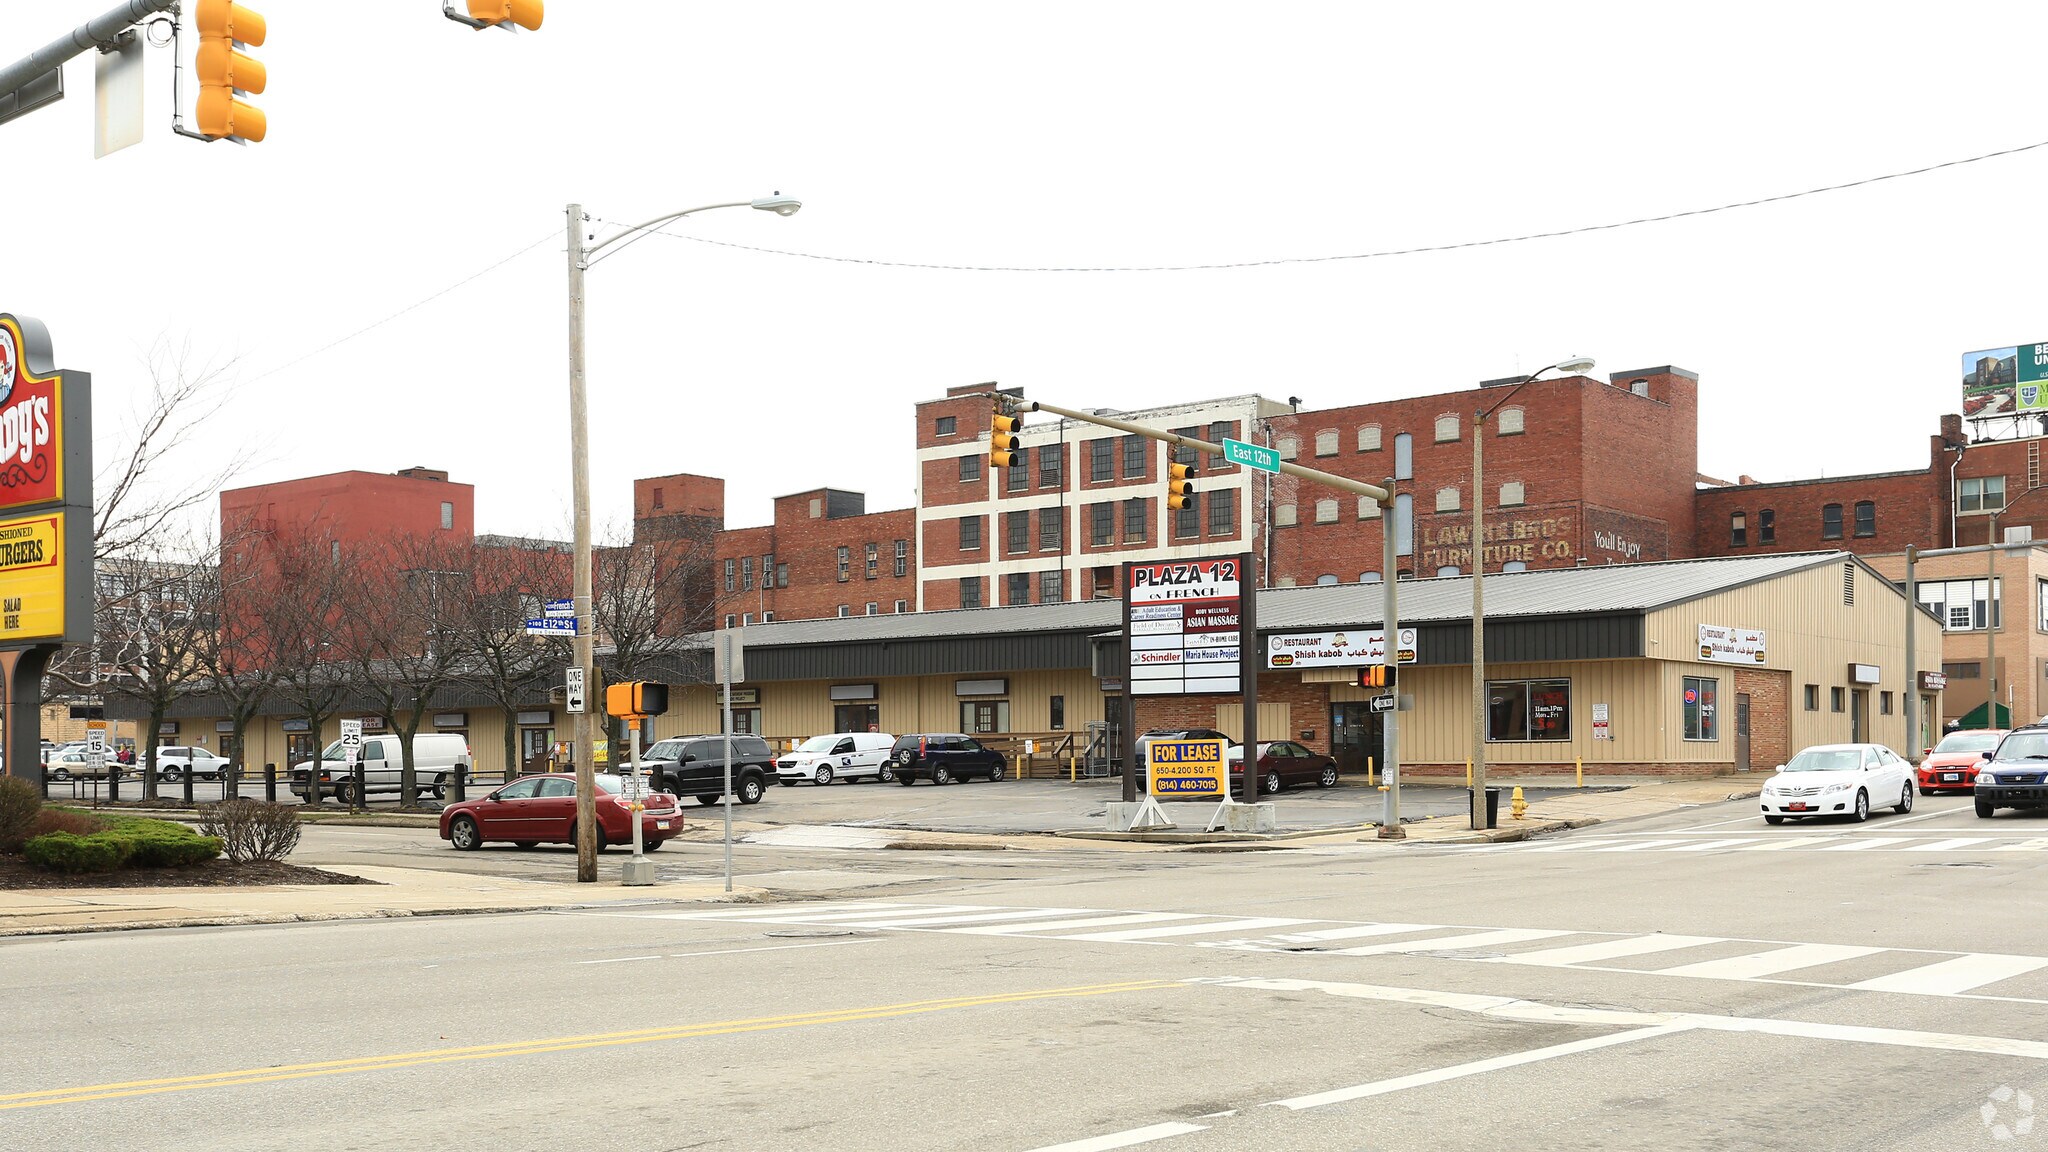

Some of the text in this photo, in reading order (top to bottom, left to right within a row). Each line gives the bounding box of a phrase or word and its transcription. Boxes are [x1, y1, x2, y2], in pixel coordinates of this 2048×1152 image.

[1233, 445, 1272, 466] East 12th
[1594, 530, 1641, 560] You'll Enjoy
[1423, 543, 1535, 568] FURNTURE
[1135, 562, 1235, 587] PLAZA 12
[1166, 587, 1219, 599] FRENCH
[4, 598, 21, 612] SALAD
[553, 601, 570, 610] French
[4, 614, 19, 629] HERE
[1186, 614, 1239, 628] ASIAN MASSAGE
[1284, 637, 1322, 646] RESTAURANT
[1141, 652, 1181, 663] Schindler
[1186, 648, 1239, 660] Maria House Project
[1295, 649, 1343, 659] Shish kabob
[568, 671, 582, 682] ONE
[568, 684, 582, 695] WAY
[343, 733, 360, 745] 25
[90, 741, 102, 751] 15
[1155, 744, 1218, 762] FOR LEASE
[1207, 765, 1217, 774] FT.
[1157, 779, 1217, 790] (814) 460-7015
